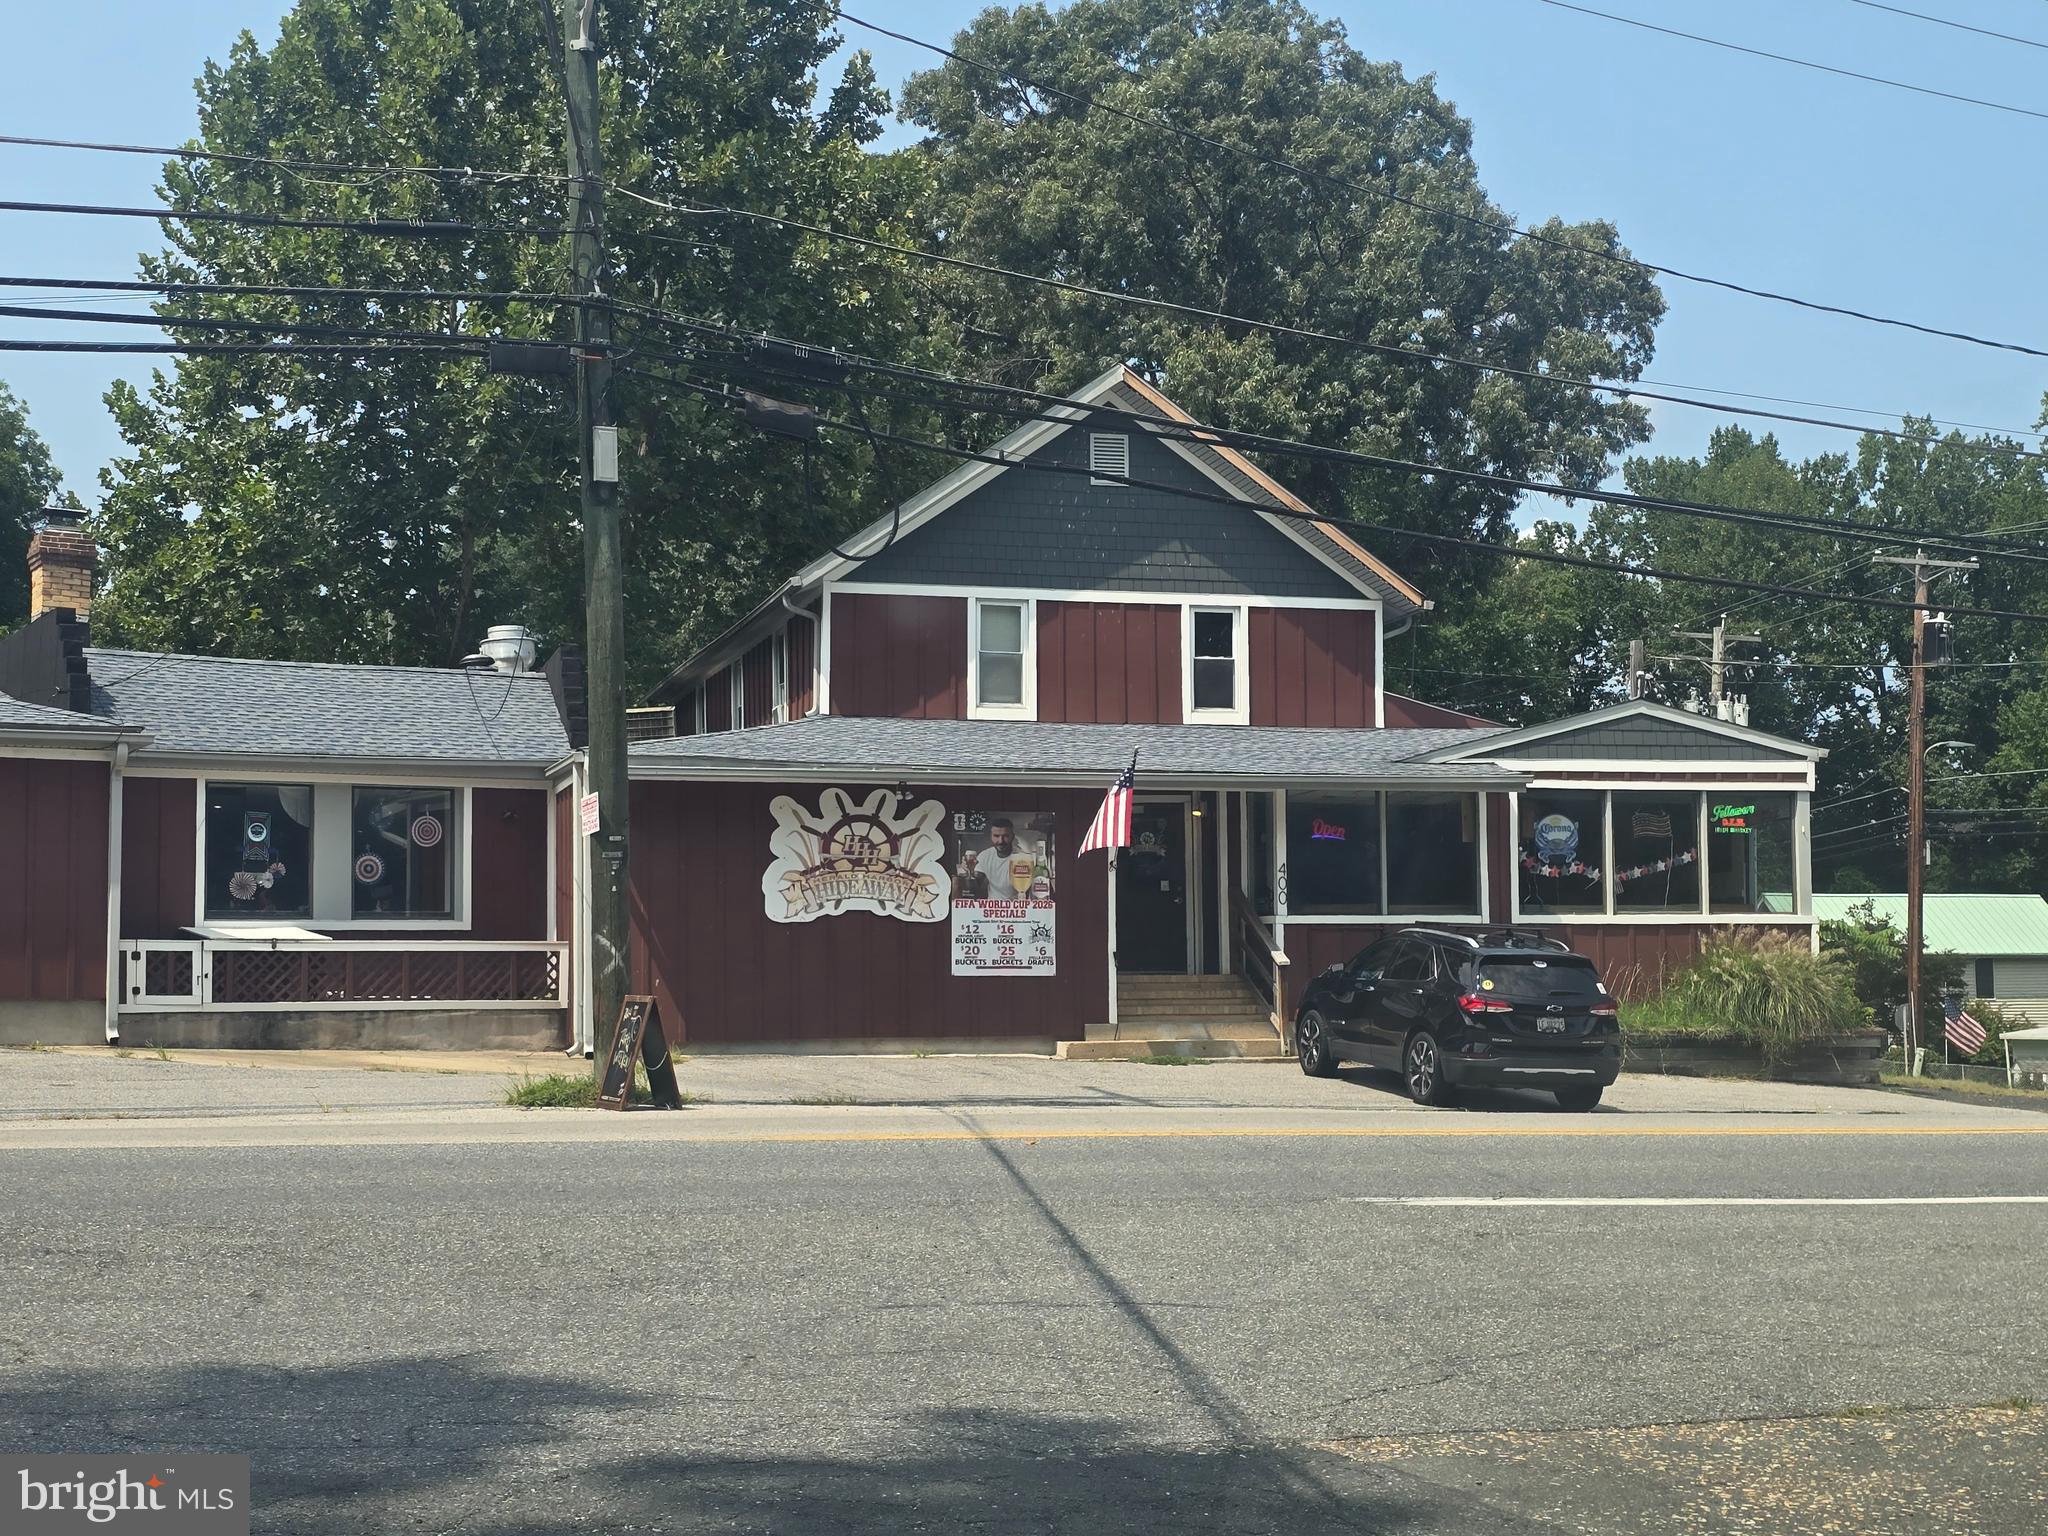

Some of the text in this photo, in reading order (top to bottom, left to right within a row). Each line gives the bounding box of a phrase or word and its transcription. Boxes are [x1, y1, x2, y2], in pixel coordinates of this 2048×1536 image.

[1312, 818, 1345, 837] Open
[1540, 823, 1572, 834] Corona
[812, 873, 909, 887] HERALD HARBOR
[1278, 862, 1287, 905] 400
[815, 879, 907, 900] HIDEAWAY
[955, 900, 1054, 909] FIFA WORLD CUP 2026
[983, 909, 1026, 919] SPECIALS
[961, 924, 980, 934] $12
[997, 924, 1015, 934] $16
[955, 937, 987, 945] BUCKETS
[992, 937, 1023, 945] BUCKETS
[961, 945, 980, 955] $20
[997, 946, 1015, 956] $25
[955, 958, 987, 966] BUCKETS
[991, 958, 1023, 966] BUCKETS
